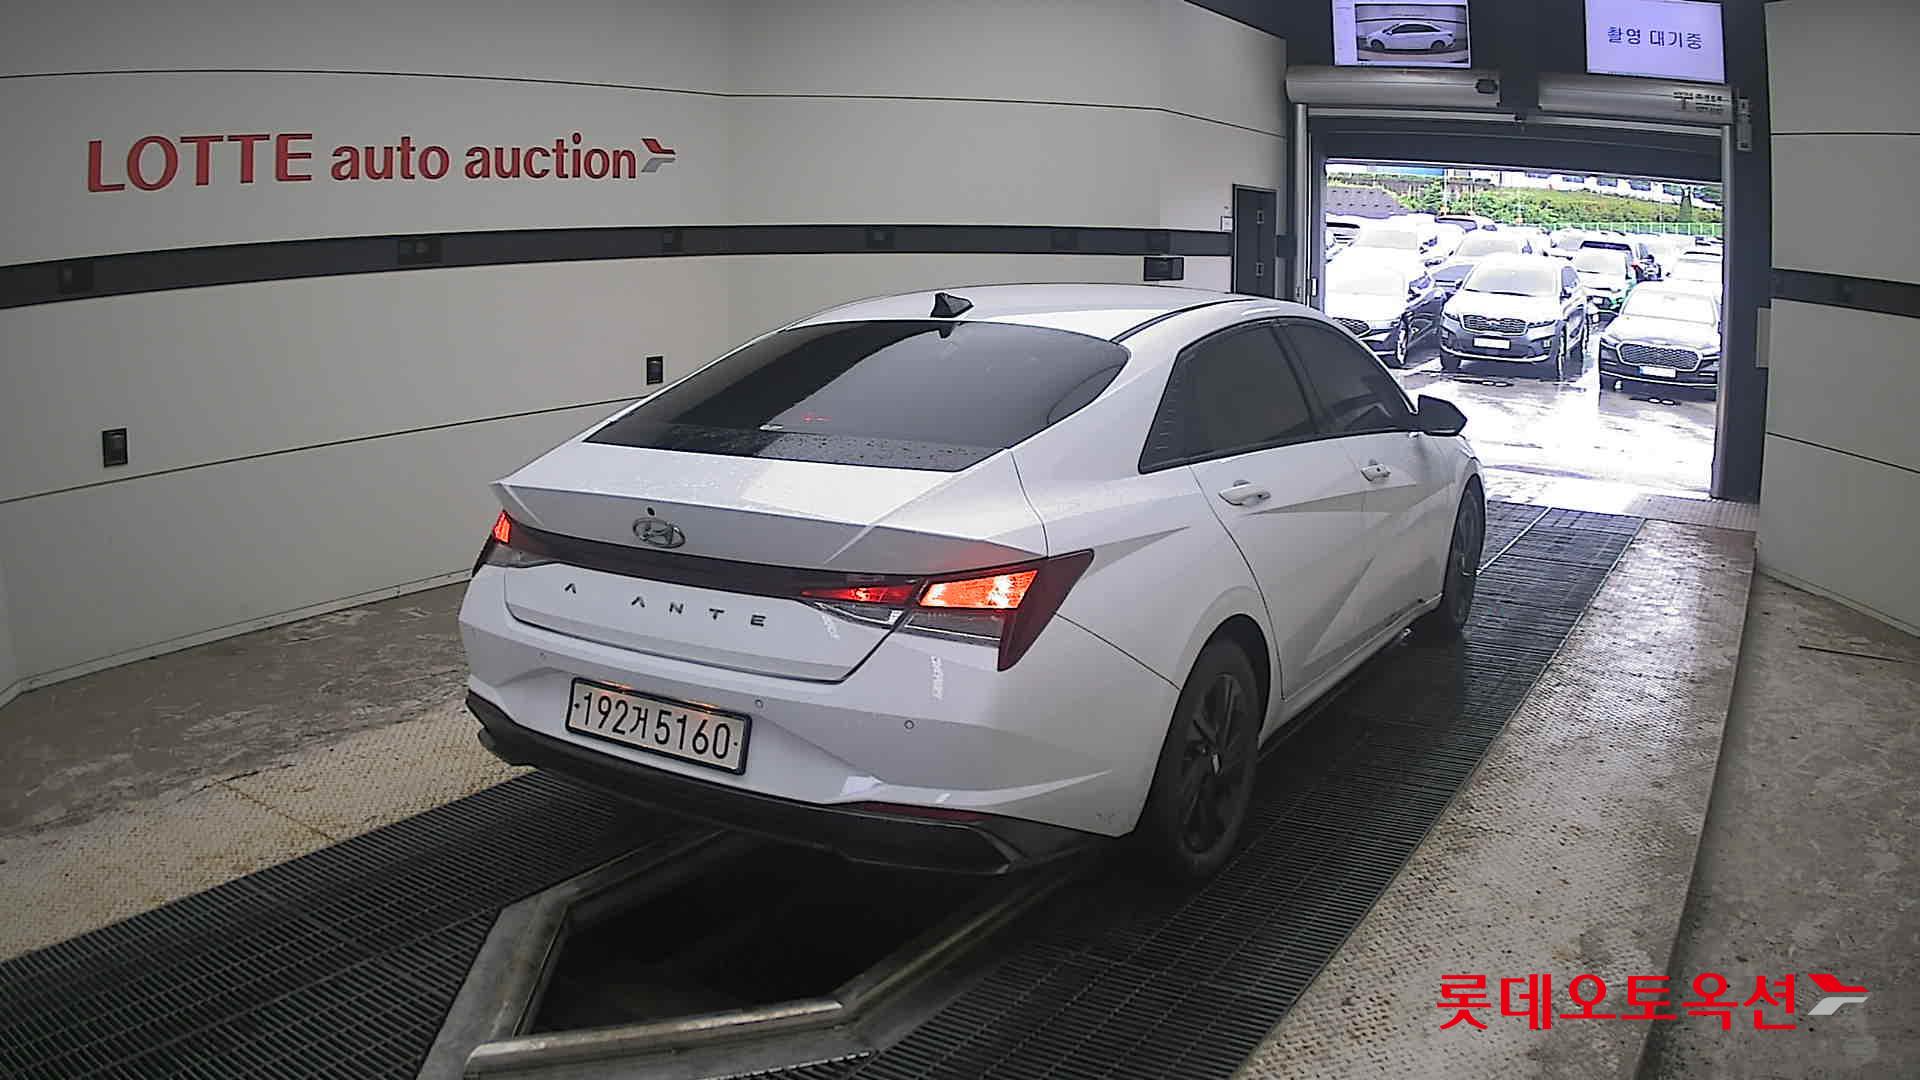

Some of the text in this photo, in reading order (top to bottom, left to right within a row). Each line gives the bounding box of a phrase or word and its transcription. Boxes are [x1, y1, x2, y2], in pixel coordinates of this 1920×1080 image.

[1650, 30, 1702, 50] 대기중
[87, 132, 637, 192] LOTTE auto auction
[564, 583, 766, 627] AANTE
